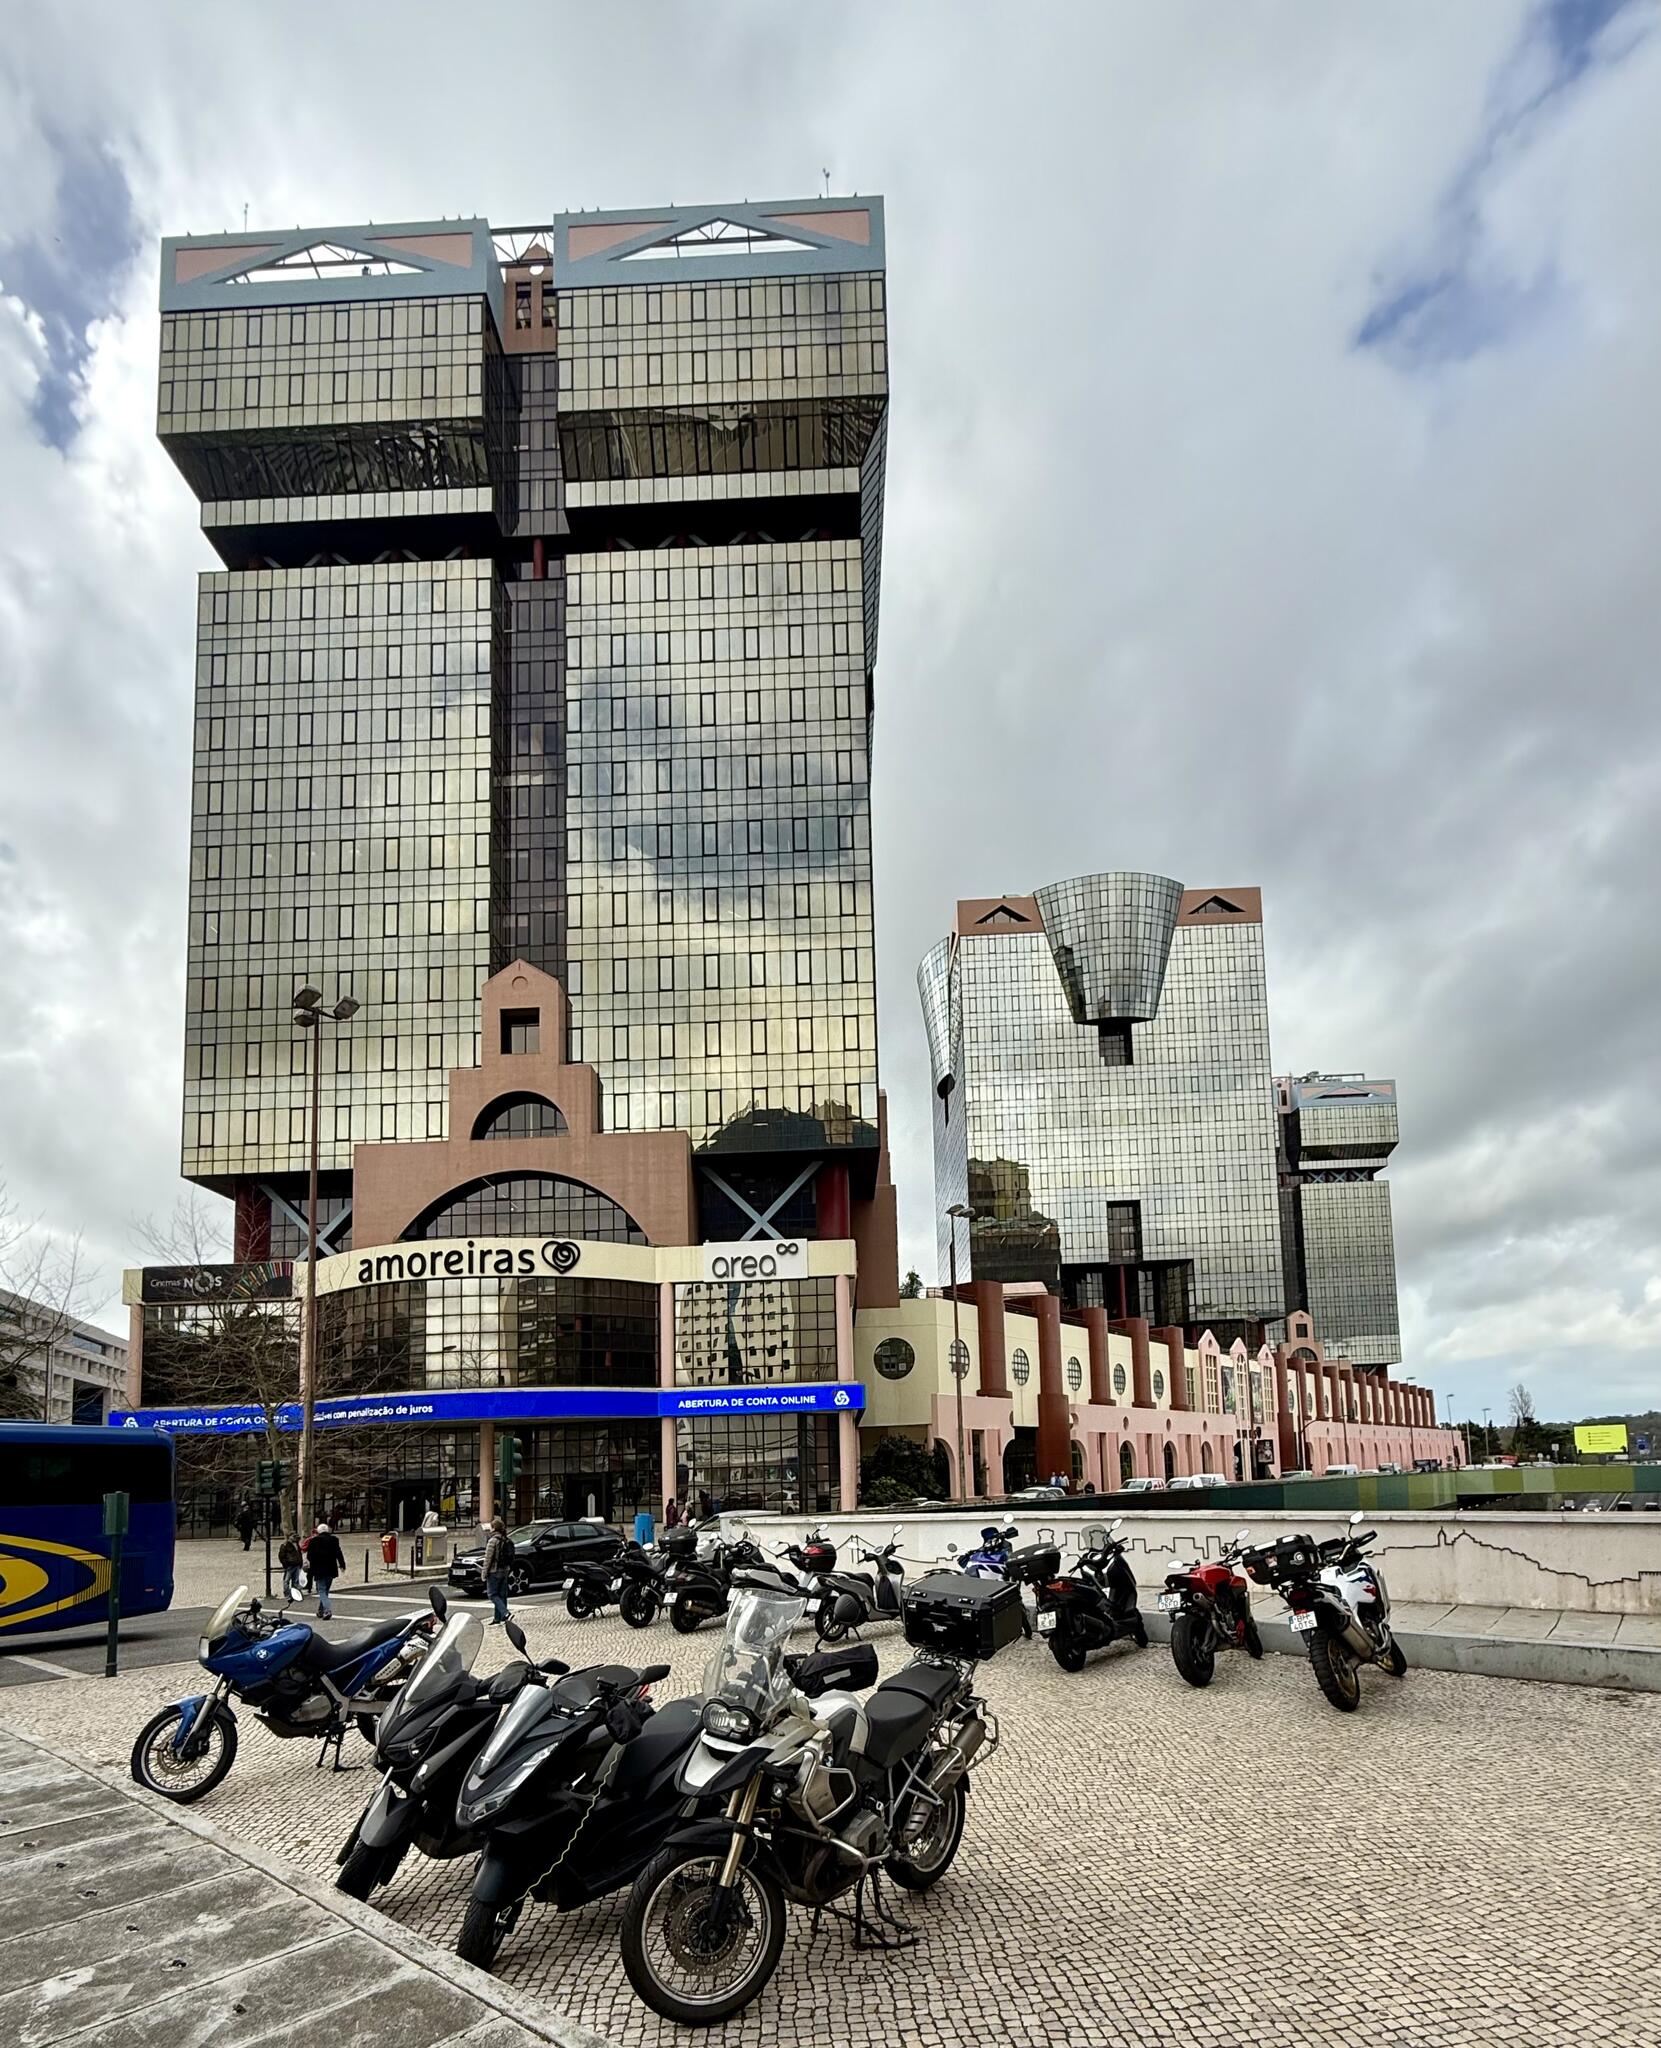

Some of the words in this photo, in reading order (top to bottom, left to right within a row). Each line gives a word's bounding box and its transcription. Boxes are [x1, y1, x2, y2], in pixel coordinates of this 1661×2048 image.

[358, 1240, 535, 1283] amoreiras
[712, 1254, 777, 1278] area
[150, 1278, 181, 1288] Cinemas
[183, 1270, 223, 1294] NOS
[333, 1411, 347, 1420] com
[347, 1406, 394, 1419] penalização
[395, 1405, 408, 1415] de
[409, 1404, 434, 1415] juros
[678, 1398, 729, 1409] ABERTURA
[731, 1398, 744, 1407] DE
[746, 1396, 779, 1406] CONTA
[780, 1395, 816, 1405] ONLINE
[153, 1417, 202, 1428] ABERTURA
[205, 1417, 218, 1426] DE
[220, 1416, 251, 1426] CONTA
